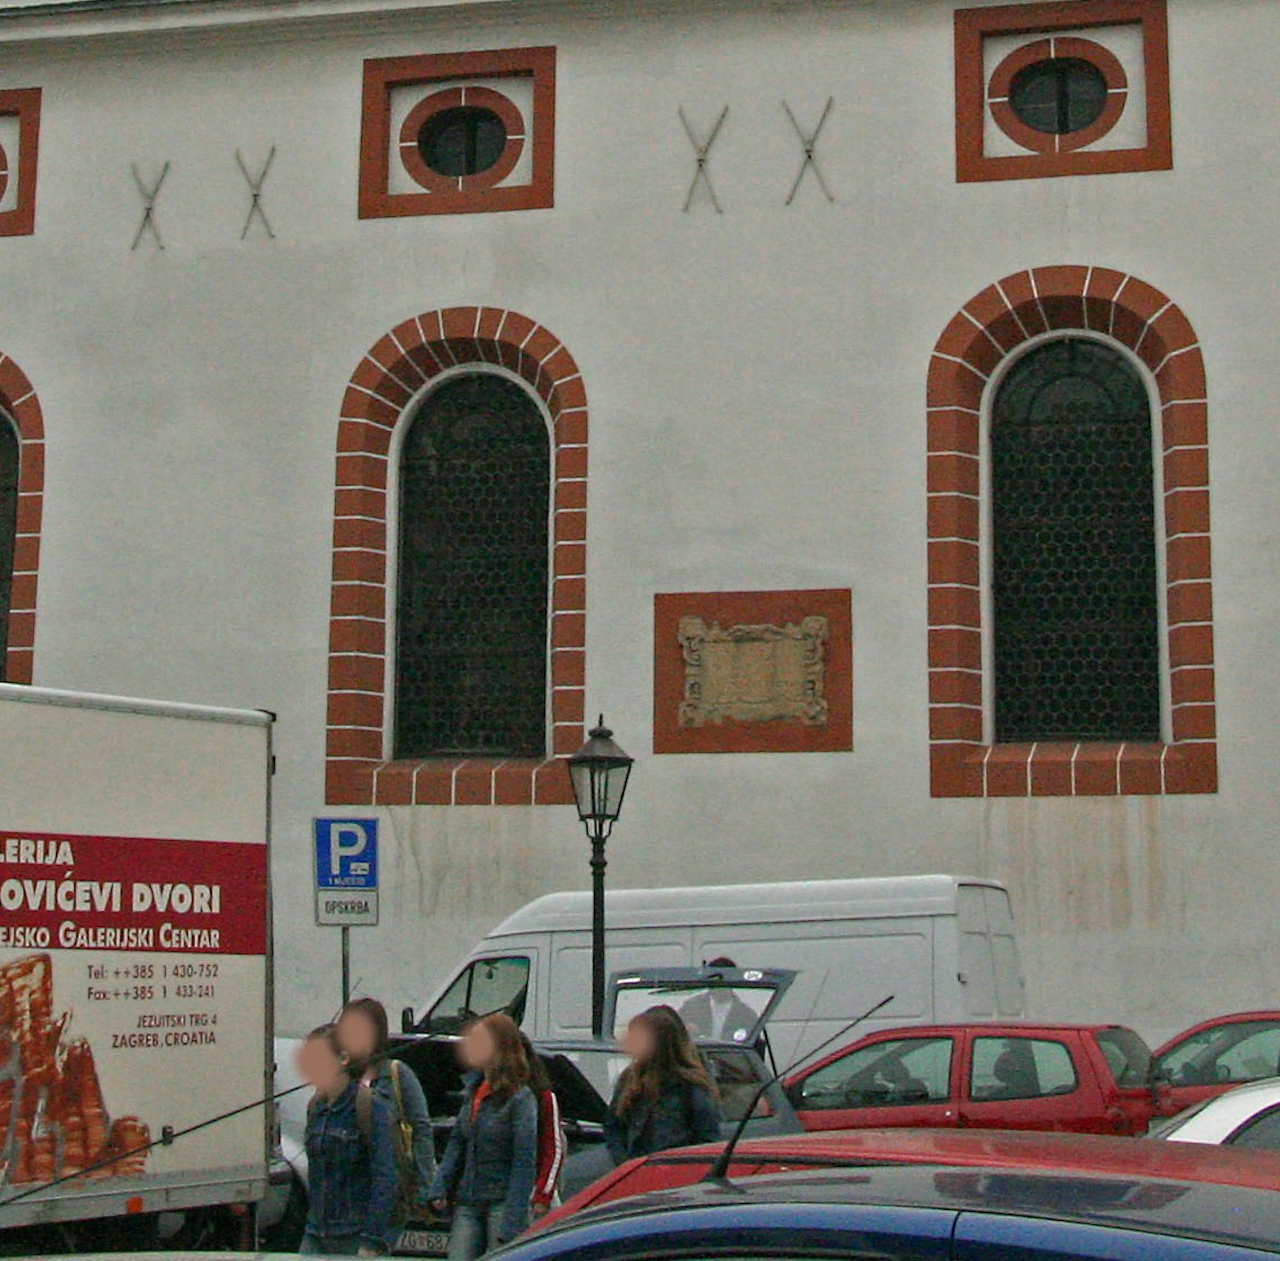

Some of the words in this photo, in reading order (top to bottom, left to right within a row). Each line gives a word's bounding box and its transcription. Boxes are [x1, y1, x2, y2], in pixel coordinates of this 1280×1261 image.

[330, 823, 367, 874] P
[132, 882, 221, 914] DVORI
[325, 901, 370, 914] OPSKRBA
[58, 921, 154, 949] GALERIJSKI
[159, 923, 220, 949] CENTAR
[87, 965, 109, 980] Tel:
[172, 964, 219, 978] 430-752
[137, 1014, 187, 1029] JEZUITSKI
[190, 1014, 209, 1027] TRG
